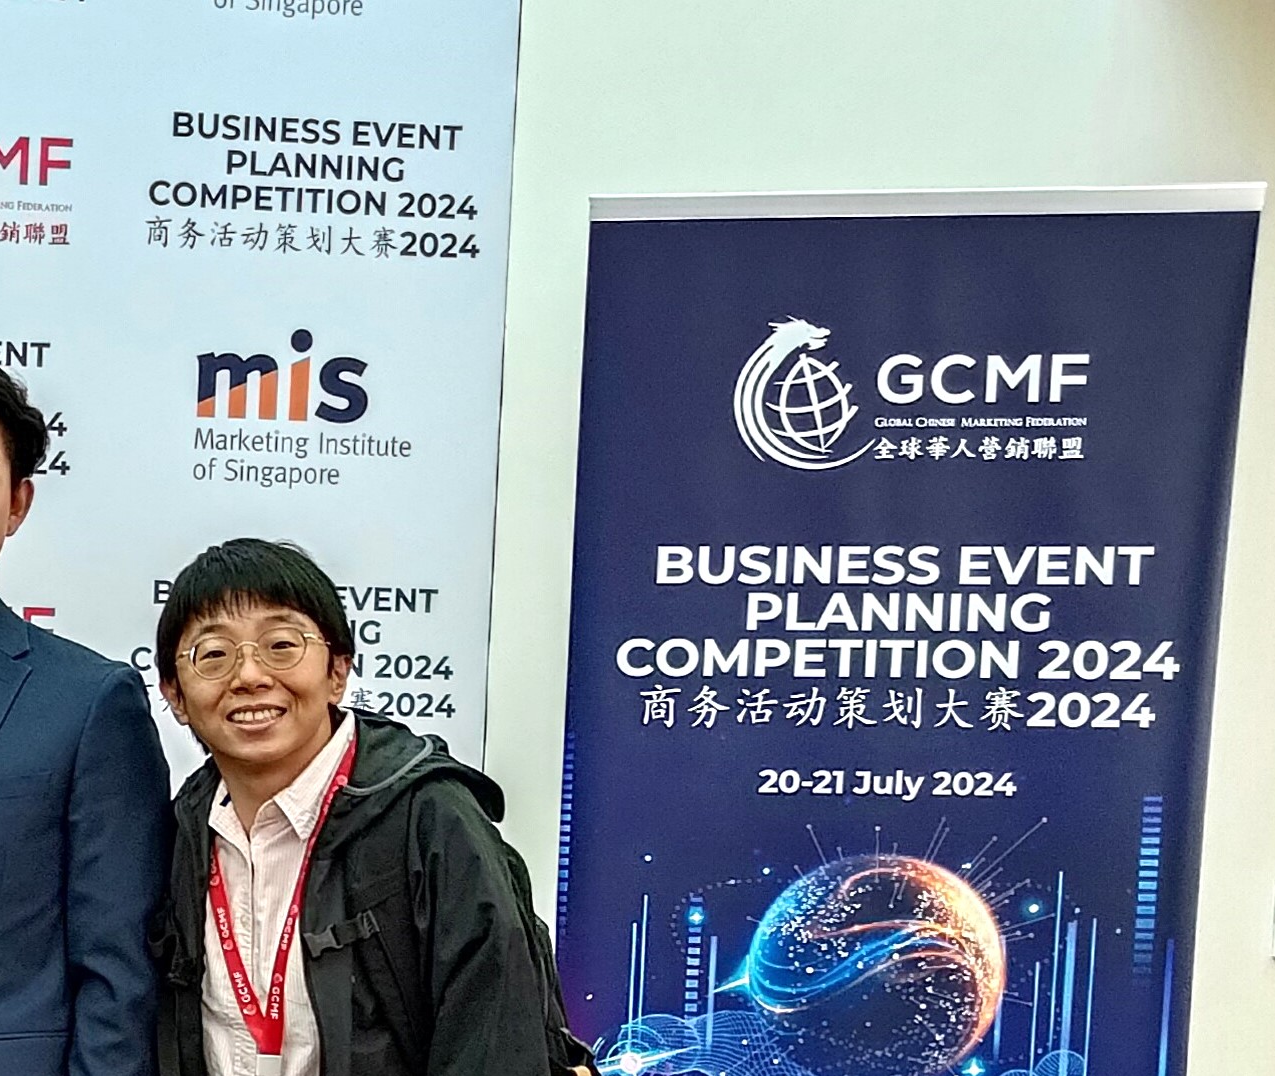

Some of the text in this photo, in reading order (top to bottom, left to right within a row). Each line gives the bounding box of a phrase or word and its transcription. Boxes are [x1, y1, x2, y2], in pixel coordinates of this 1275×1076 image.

[173, 112, 463, 150] BUSINESS EVENT
[227, 150, 404, 182] PLANNING
[149, 180, 477, 220] COMPETITION 2024
[197, 329, 368, 423] mis
[877, 354, 1090, 404] GCMF
[194, 428, 411, 459] Marketing Institute
[193, 458, 339, 489] of Singapore
[655, 545, 1155, 587] BUSINESS EVENT
[744, 592, 1051, 633] PLANNING
[375, 654, 454, 680] 2024
[615, 637, 1180, 681] COMPETITION 2024
[640, 683, 1156, 733] 商务活动策划大赛2024
[758, 768, 1017, 800] 20-21 July 2024
[233, 971, 250, 1003] GCMF
[270, 986, 280, 1020] GCMF
